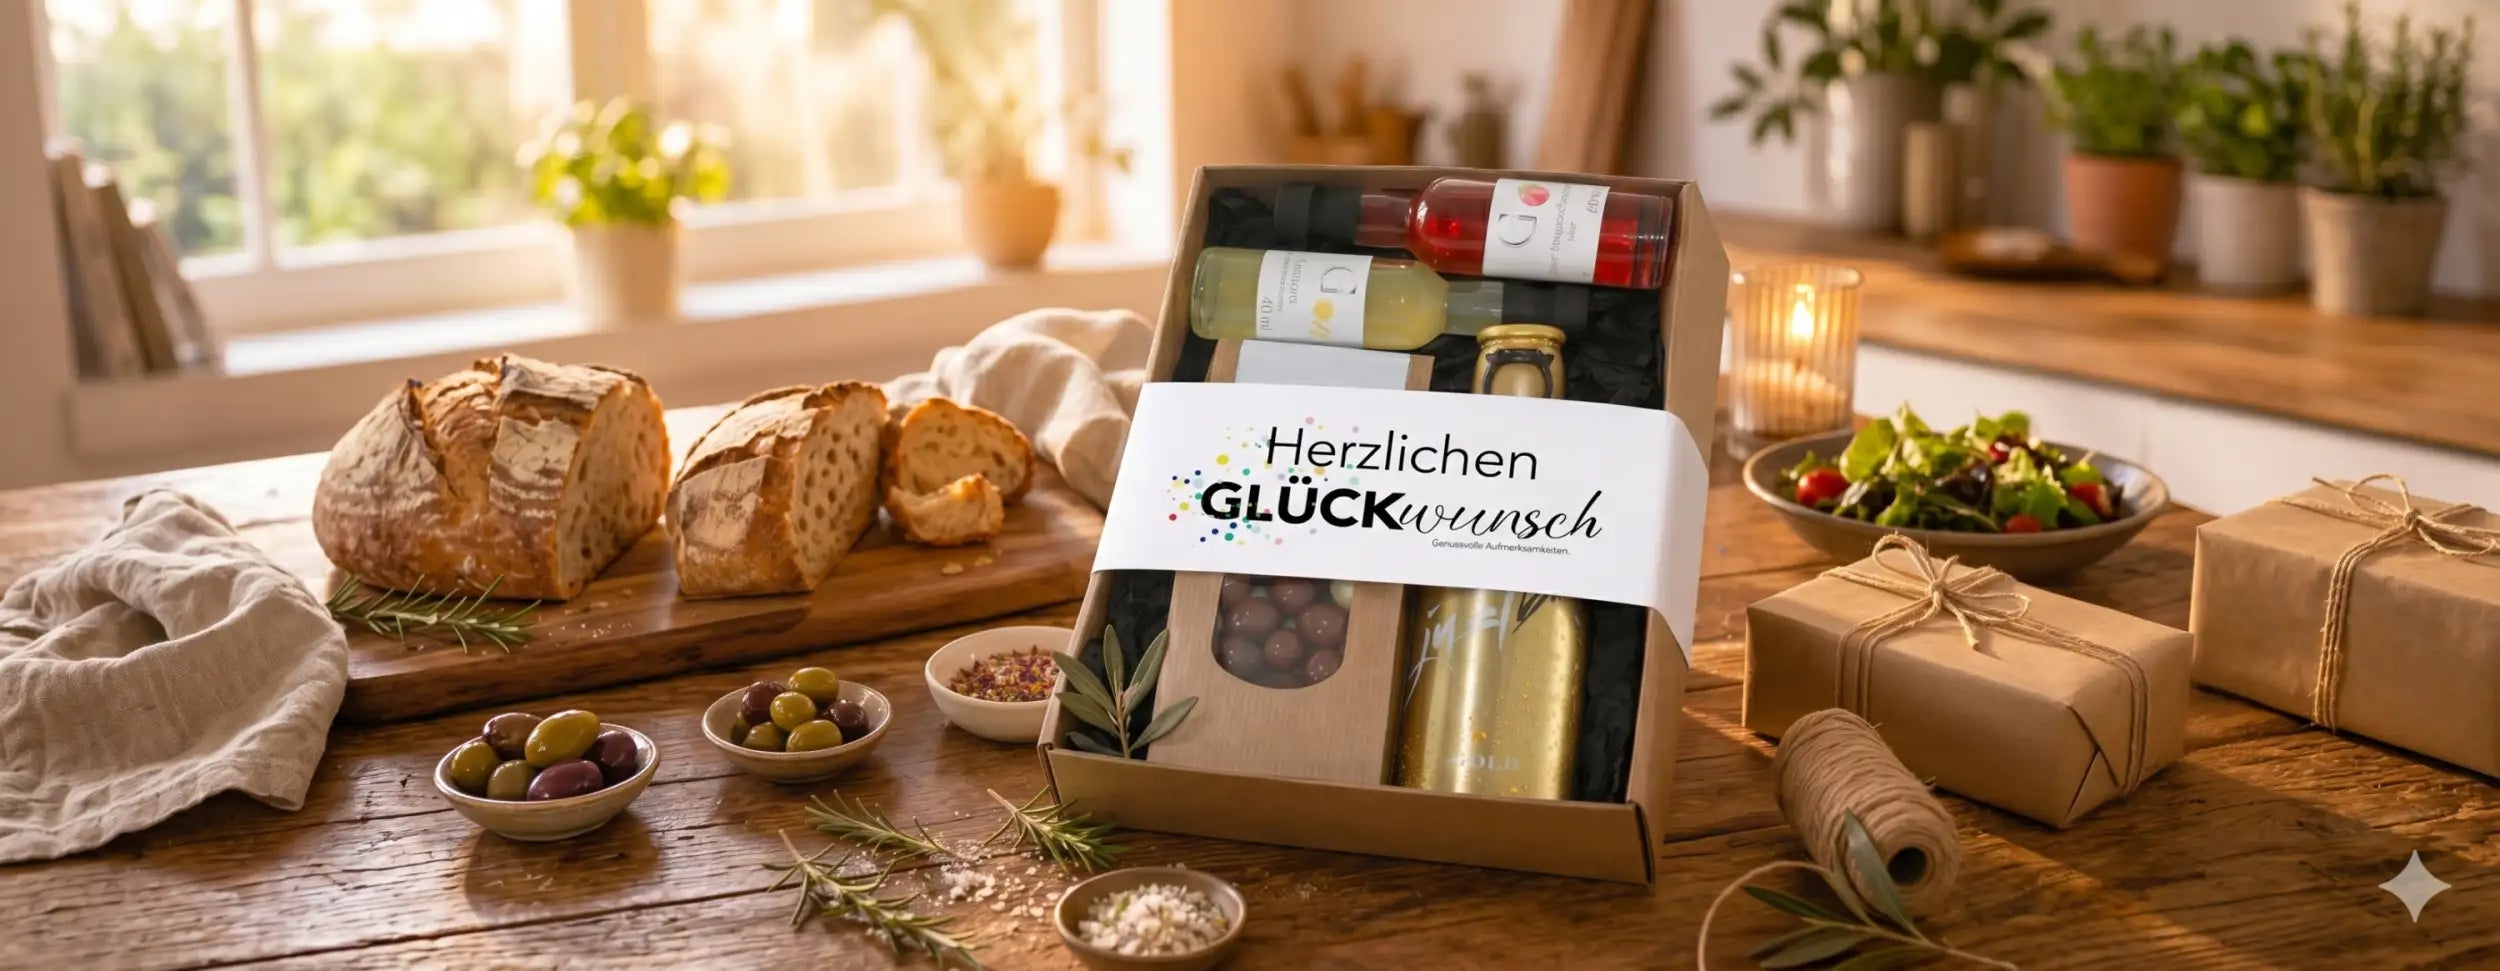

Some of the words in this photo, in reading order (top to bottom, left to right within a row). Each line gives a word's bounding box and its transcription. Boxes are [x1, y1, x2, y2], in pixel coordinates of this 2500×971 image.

[1260, 296, 1273, 314] 40
[1267, 426, 1538, 480] Herzlichen
[1431, 538, 1484, 550] Genussvolle
[1485, 542, 1571, 555] Aufmerksamkeiten.
